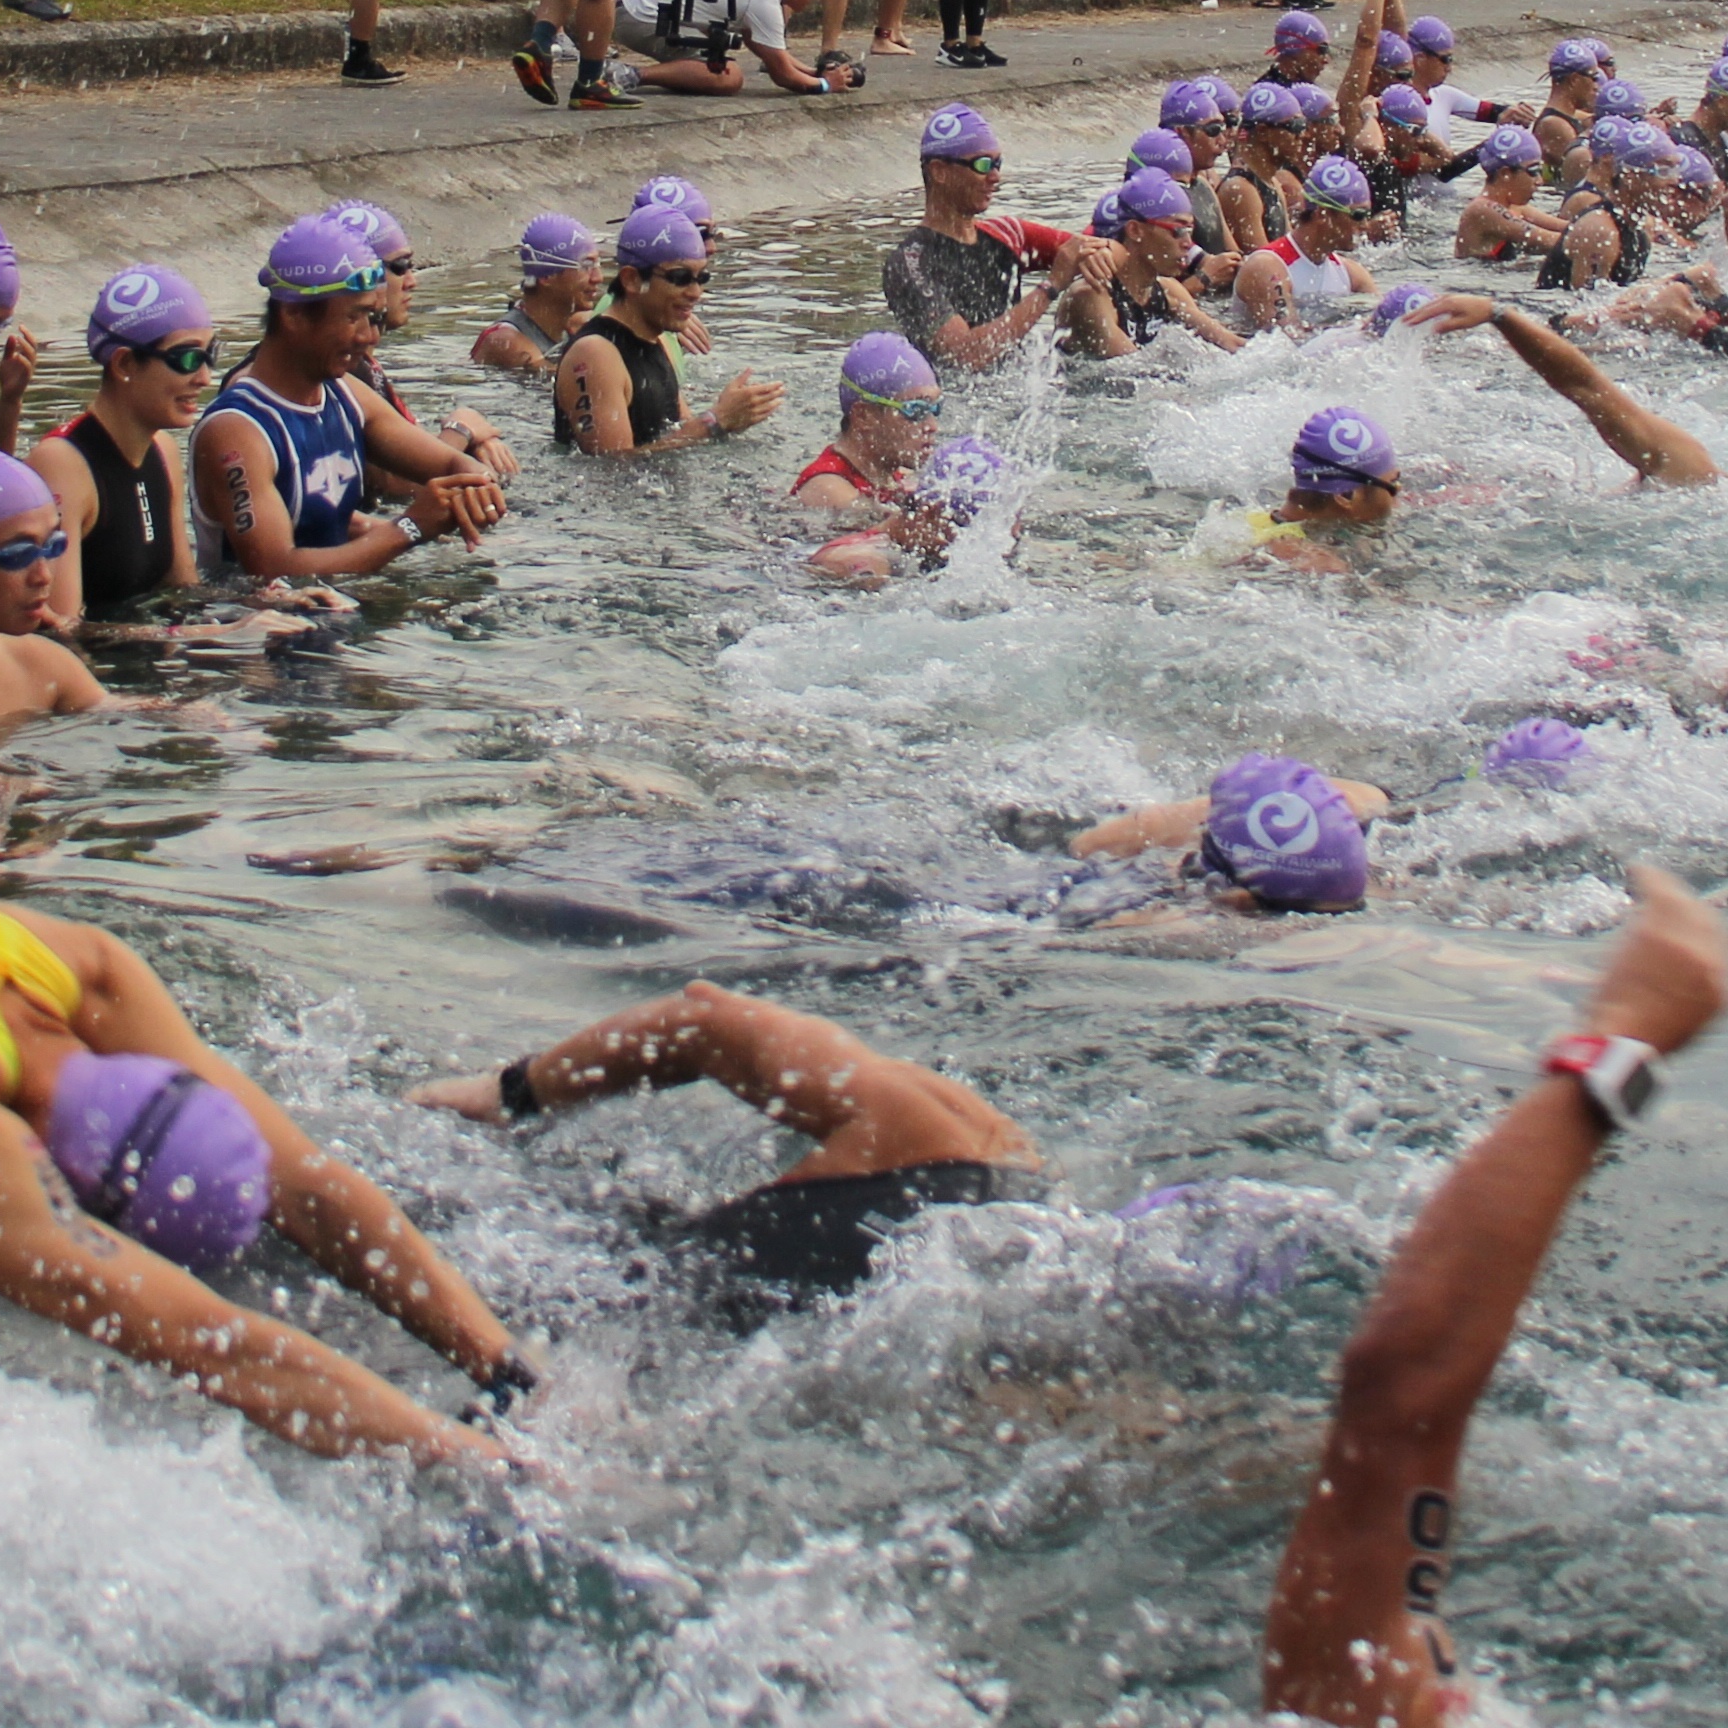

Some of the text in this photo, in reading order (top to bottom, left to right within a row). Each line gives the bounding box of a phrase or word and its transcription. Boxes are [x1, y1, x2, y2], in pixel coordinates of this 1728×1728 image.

[1158, 188, 1175, 205] A
[650, 225, 672, 248] A
[332, 252, 355, 275] A
[892, 354, 912, 374] A
[226, 465, 254, 535] 229
[136, 481, 155, 543] HUUB
